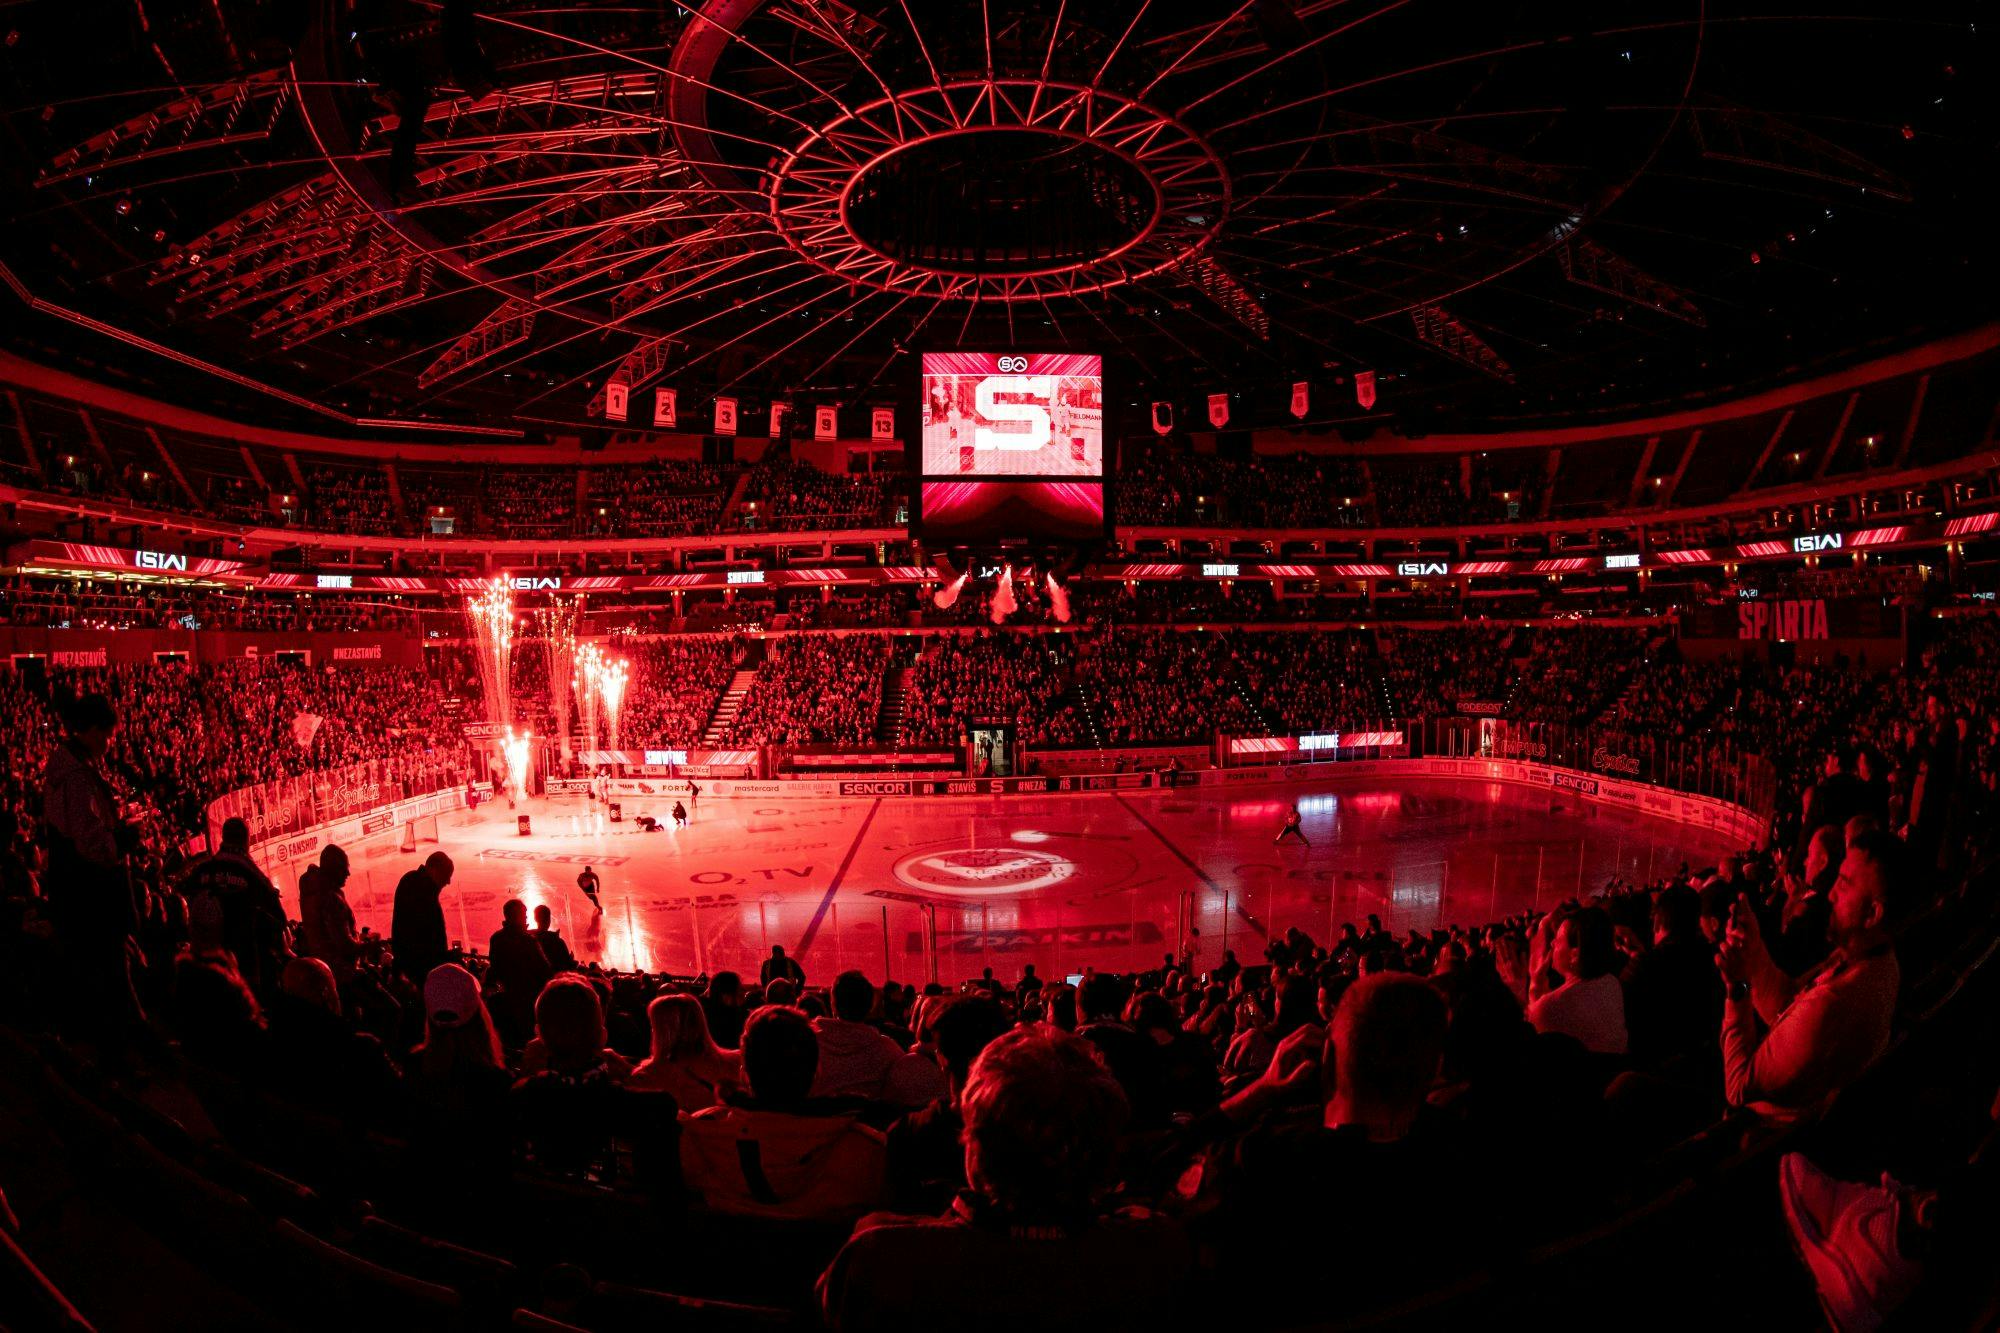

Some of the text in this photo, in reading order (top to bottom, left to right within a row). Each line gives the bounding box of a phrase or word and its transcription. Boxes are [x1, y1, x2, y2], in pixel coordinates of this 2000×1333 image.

[613, 395, 620, 409] 1
[661, 402, 671, 416] 2
[721, 411, 731, 424] 3
[975, 376, 1050, 451] S
[822, 419, 832, 431] 9
[875, 421, 891, 433] 13
[1739, 599, 1829, 641] SPARTA
[1299, 734, 1339, 750] SHOWTIME
[645, 751, 688, 765] SHOWTIME
[734, 785, 779, 793] mastercard
[843, 782, 906, 795] SENCOR
[1556, 775, 1596, 794] SENCOR
[288, 837, 318, 857] FANSHOP
[752, 866, 814, 880] TV
